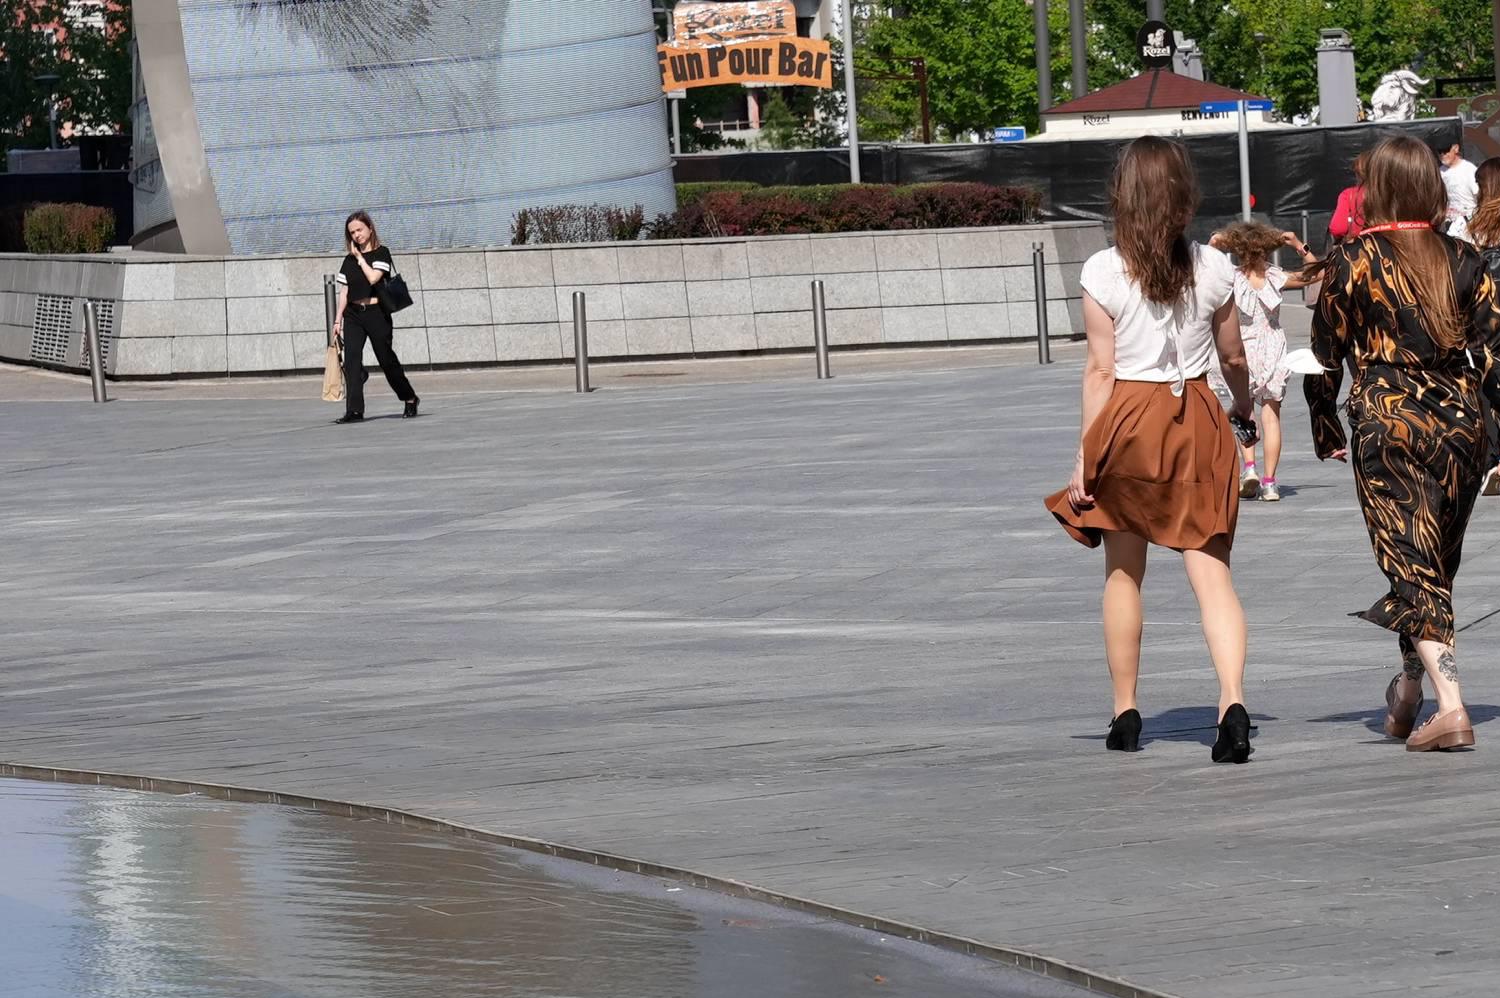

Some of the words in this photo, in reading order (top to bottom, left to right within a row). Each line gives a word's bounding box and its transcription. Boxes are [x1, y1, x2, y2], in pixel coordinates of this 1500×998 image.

[1143, 45, 1170, 57] Kozel
[657, 50, 704, 86] Fun
[706, 45, 772, 78] Pour
[778, 41, 828, 80] Bar
[1083, 114, 1111, 126] Kozel
